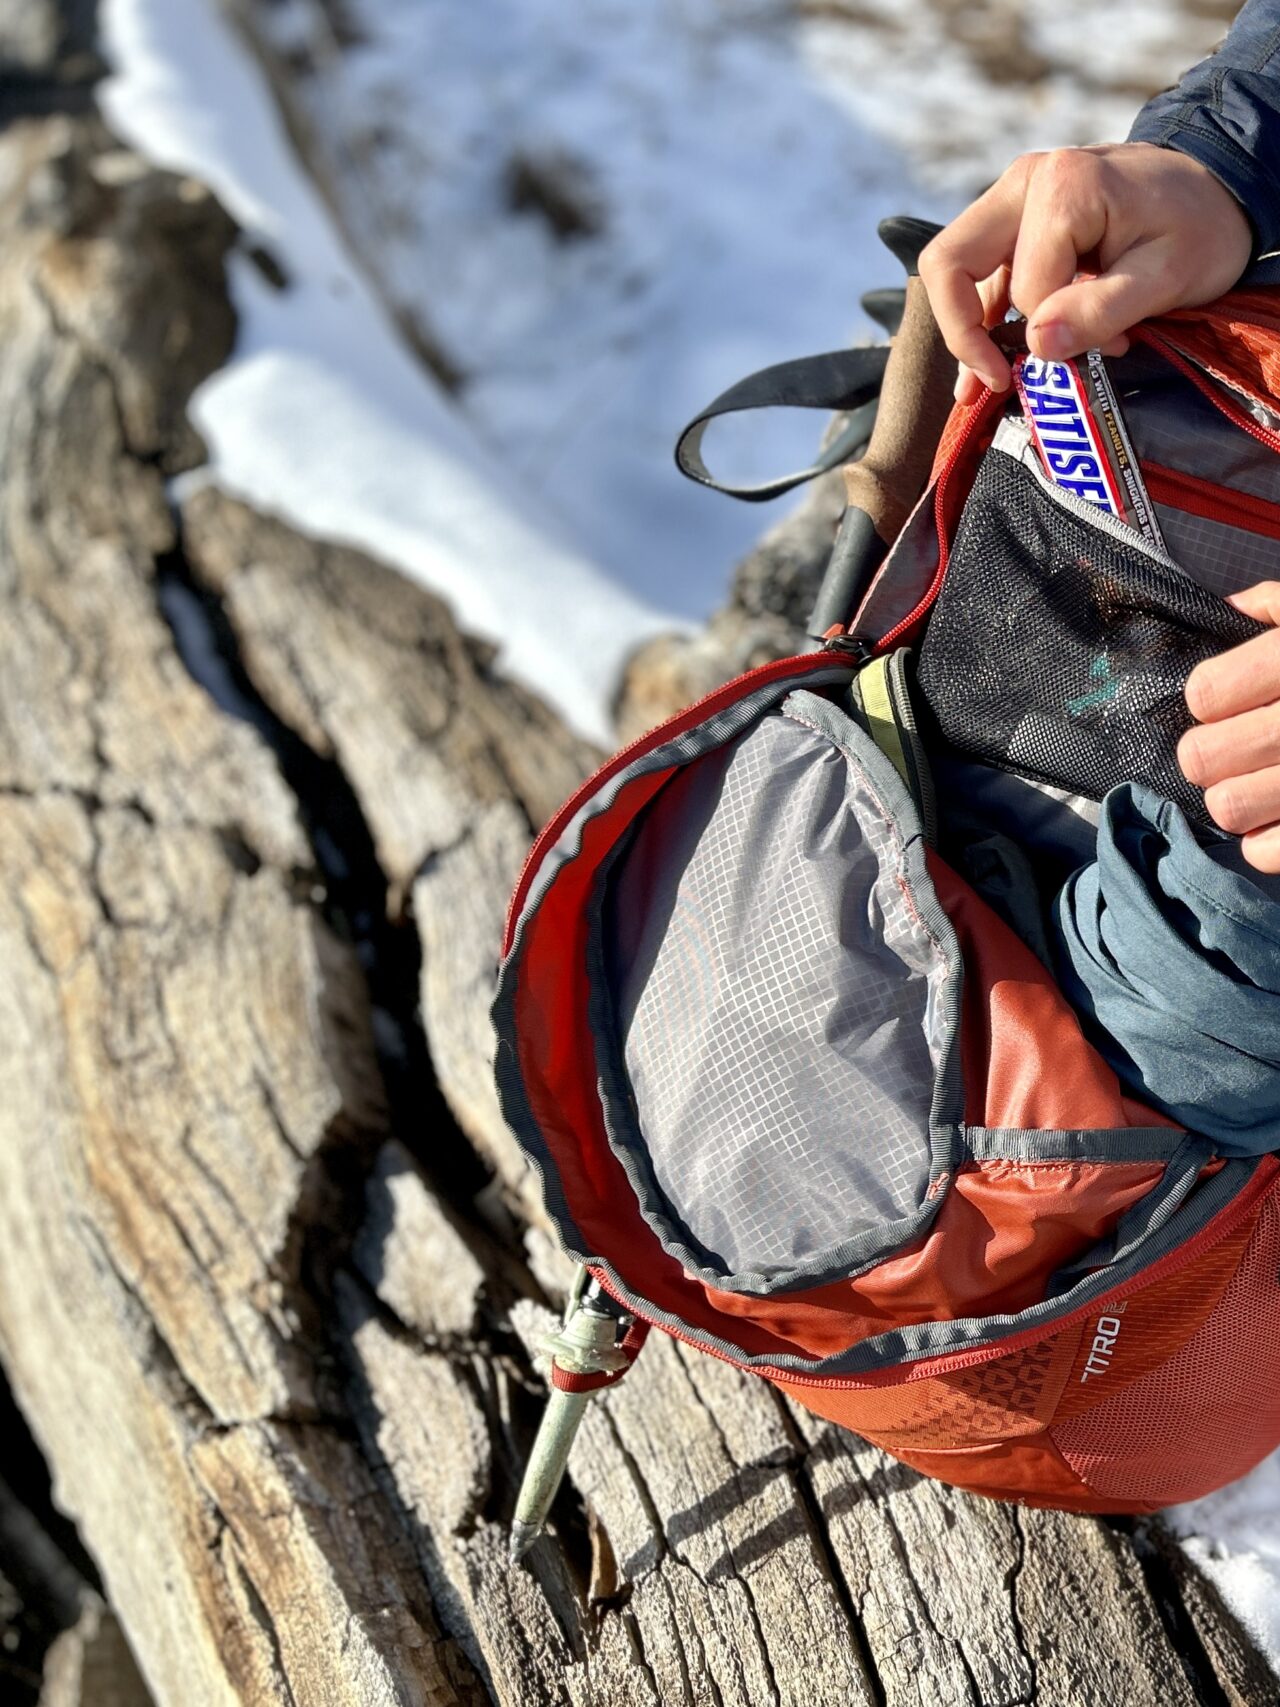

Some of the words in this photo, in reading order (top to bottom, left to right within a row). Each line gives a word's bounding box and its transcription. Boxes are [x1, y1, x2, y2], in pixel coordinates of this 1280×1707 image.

[1094, 380, 1110, 412] WITH
[1104, 411, 1127, 469] PEANUTS,
[1123, 468, 1148, 526] SNICKERS
[1080, 1316, 1121, 1384] ITRO
